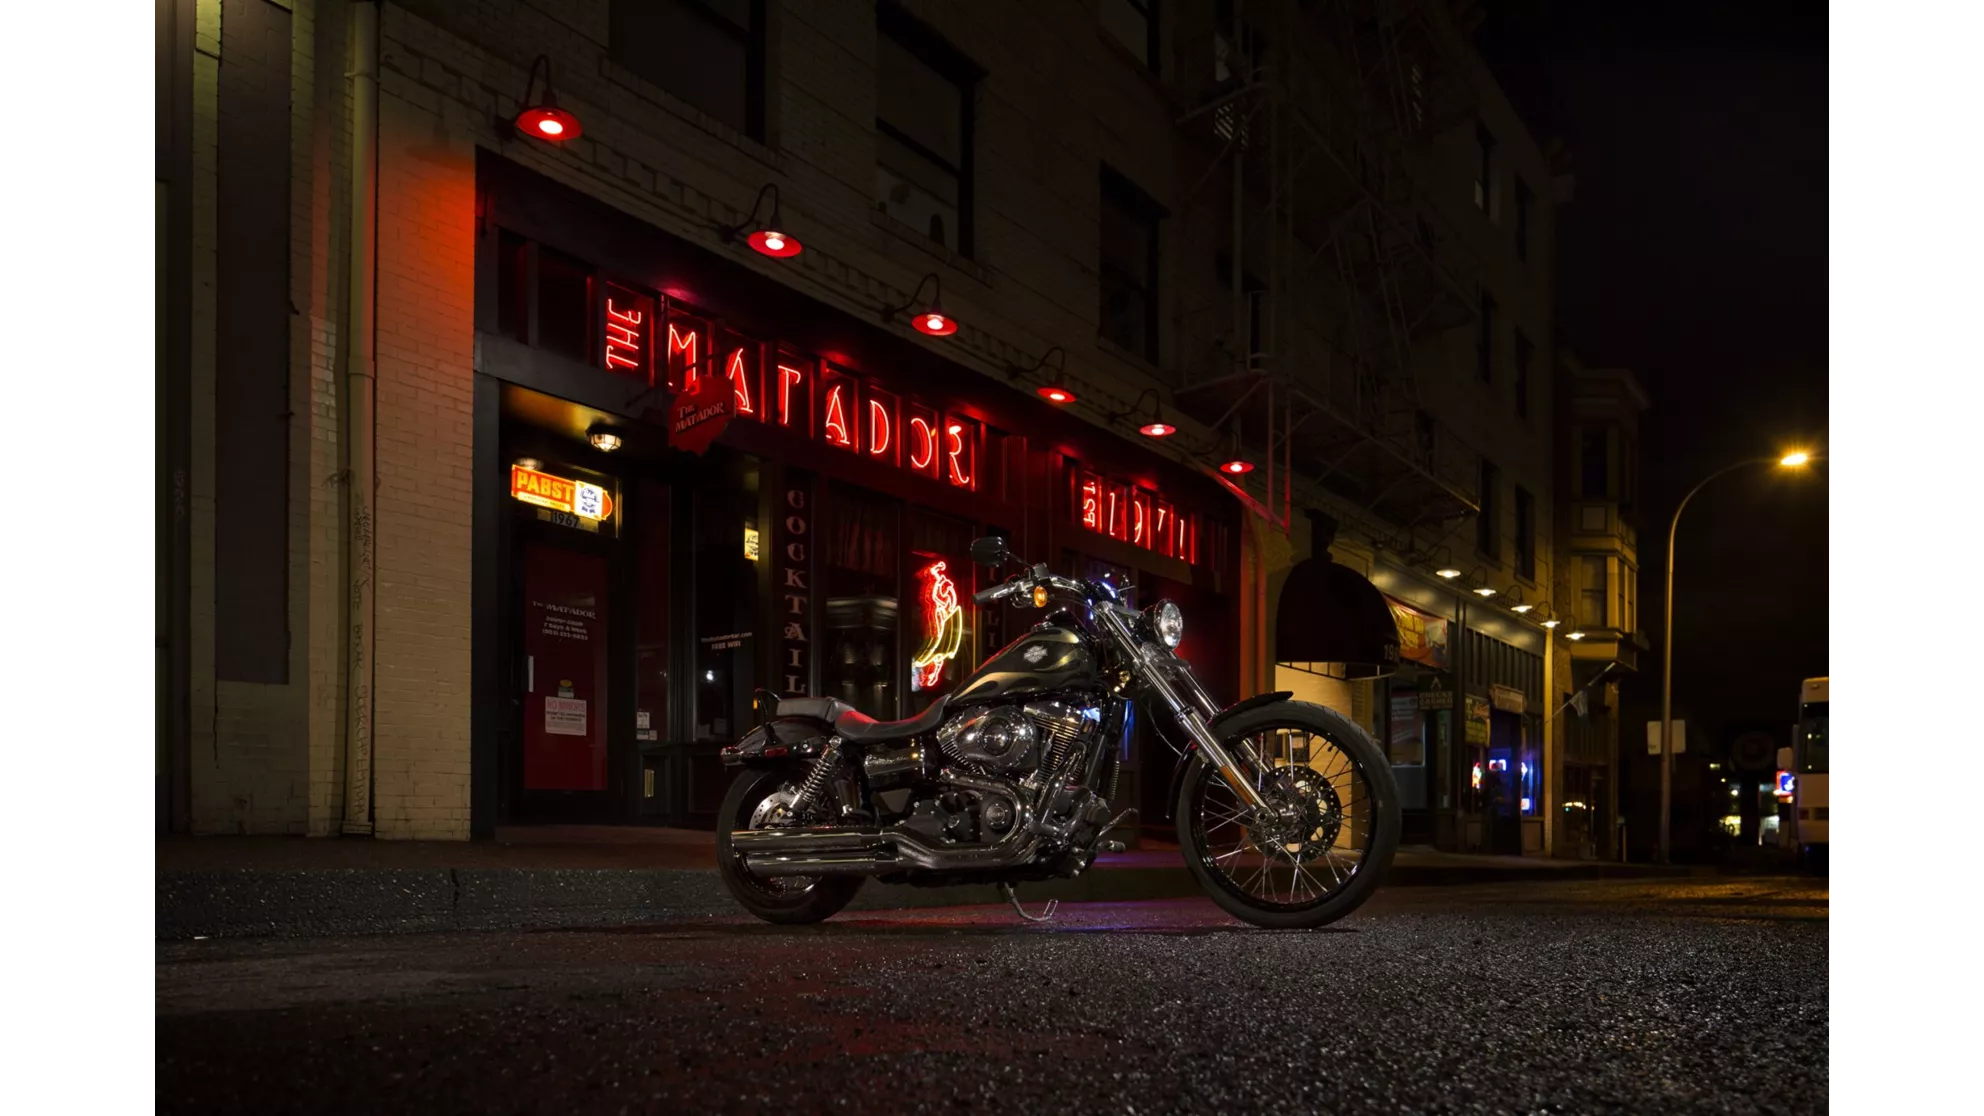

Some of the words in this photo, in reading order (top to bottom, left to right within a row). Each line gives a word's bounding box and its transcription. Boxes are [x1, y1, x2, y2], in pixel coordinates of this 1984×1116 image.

[606, 298, 642, 369] THE
[667, 322, 970, 485] MATADOR
[675, 401, 725, 433] MATADOR
[516, 470, 575, 503] PABST
[553, 511, 581, 528] 1967
